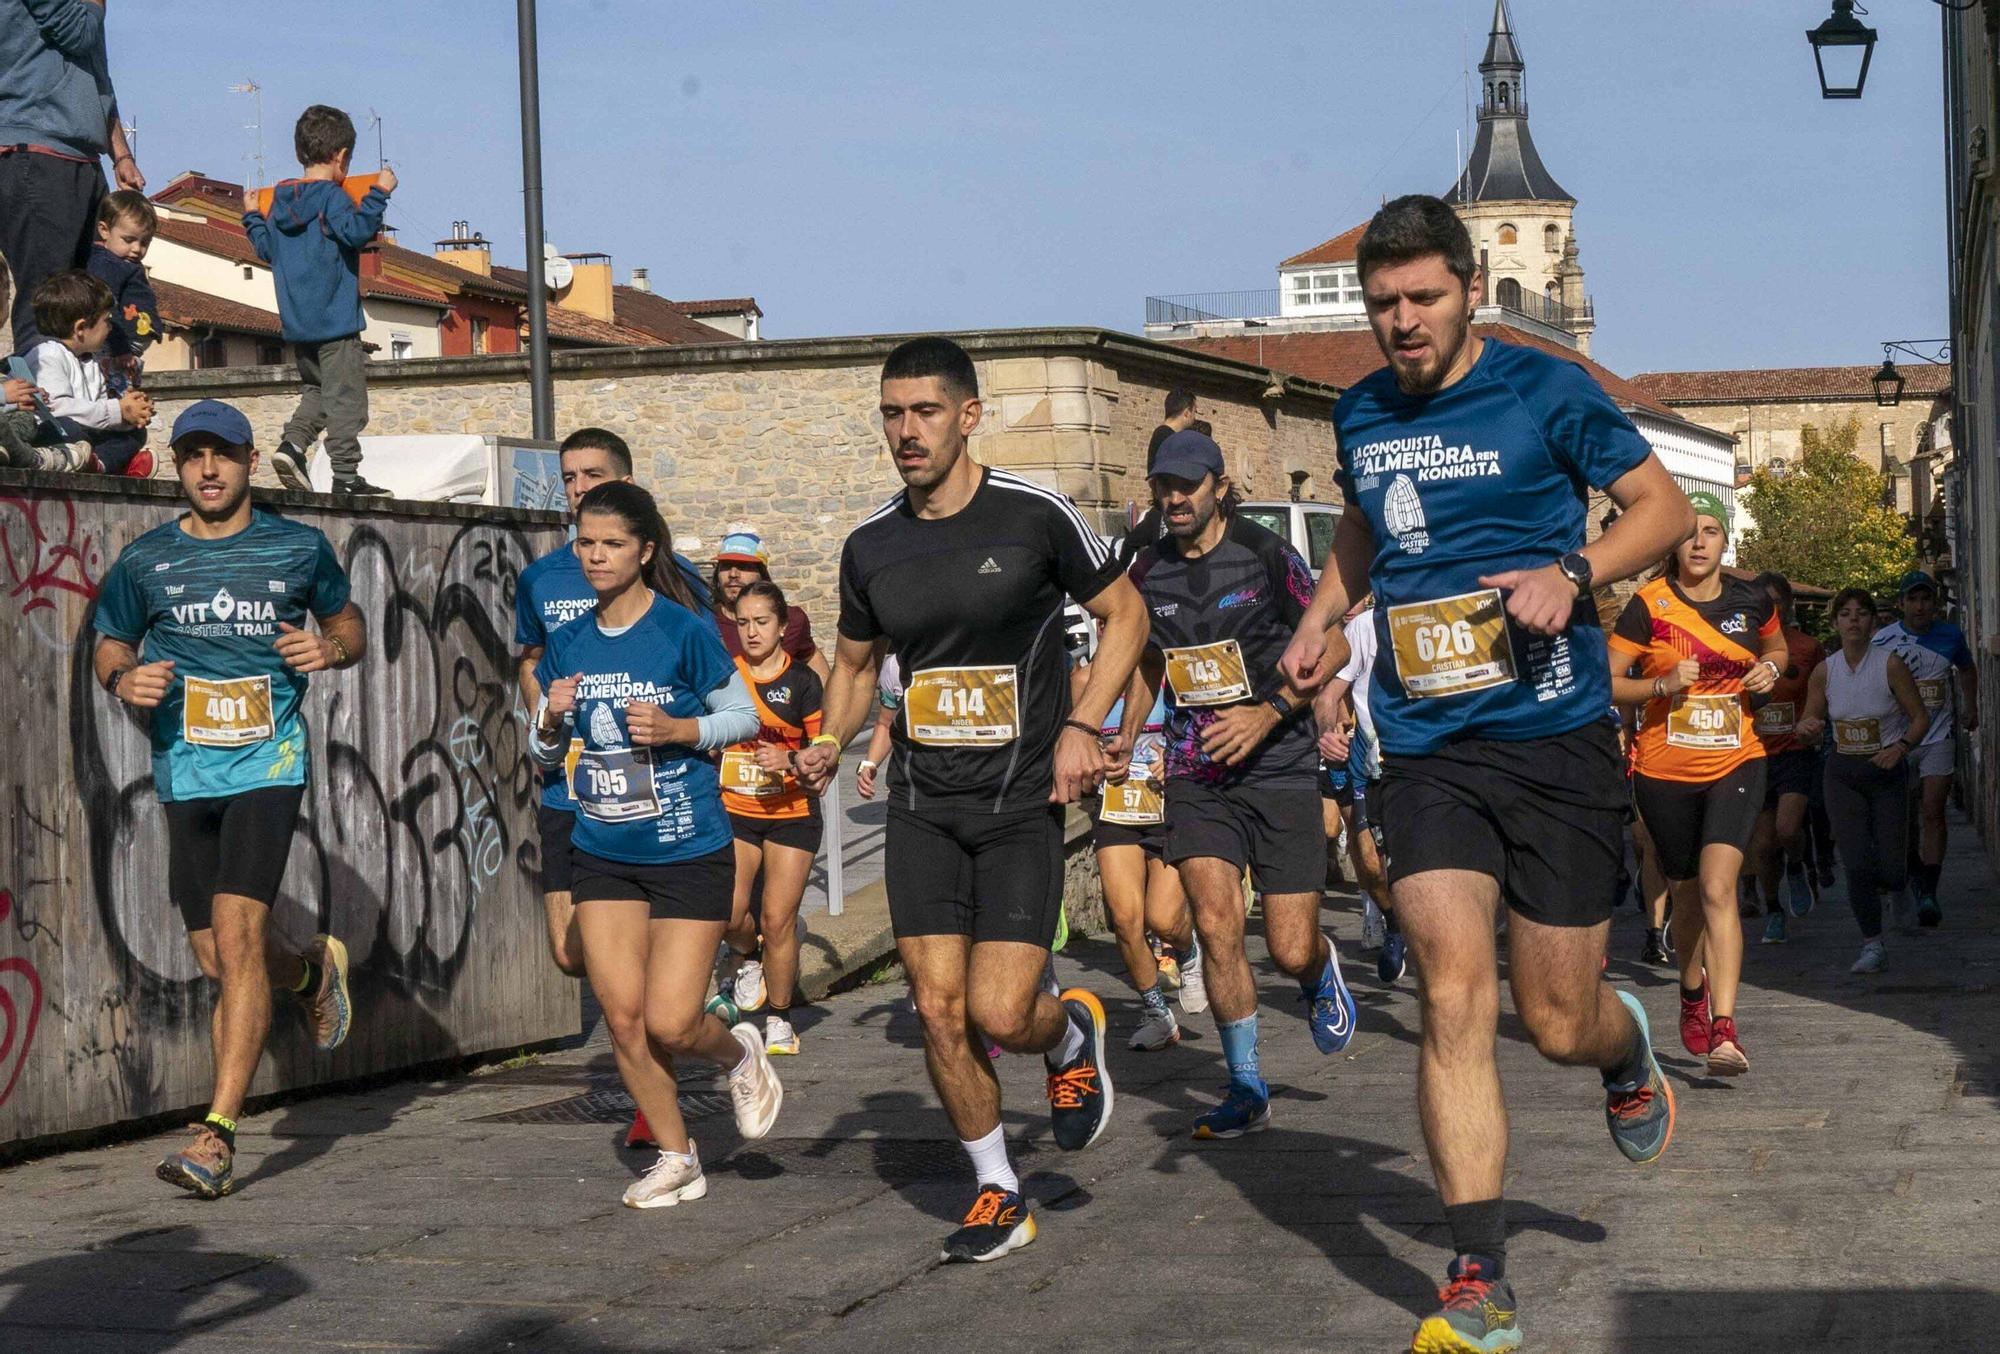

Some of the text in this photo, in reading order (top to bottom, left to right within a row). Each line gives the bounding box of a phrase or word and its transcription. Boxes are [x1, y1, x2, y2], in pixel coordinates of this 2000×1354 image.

[1363, 435, 1442, 458] CONQUISTA
[1363, 445, 1474, 475] ALMENDRA
[1476, 450, 1499, 462] REN
[1418, 461, 1501, 482] KONKISTA
[172, 588, 276, 624] VITORIA
[556, 599, 599, 610] CONQU
[233, 622, 275, 636] TRAIL
[1416, 620, 1475, 661] 626
[1186, 659, 1221, 684] 143
[1432, 660, 1466, 672] CRISTIAN
[578, 672, 630, 686] ONQUISTA
[576, 681, 656, 700] ALMENDRA
[206, 696, 247, 722] 401
[613, 693, 675, 709] KOKISTA
[937, 688, 986, 716] 414
[1688, 709, 1725, 729] 450
[587, 768, 627, 796] 795
[655, 769, 676, 778] ABORAL
[1123, 789, 1141, 808] 57
